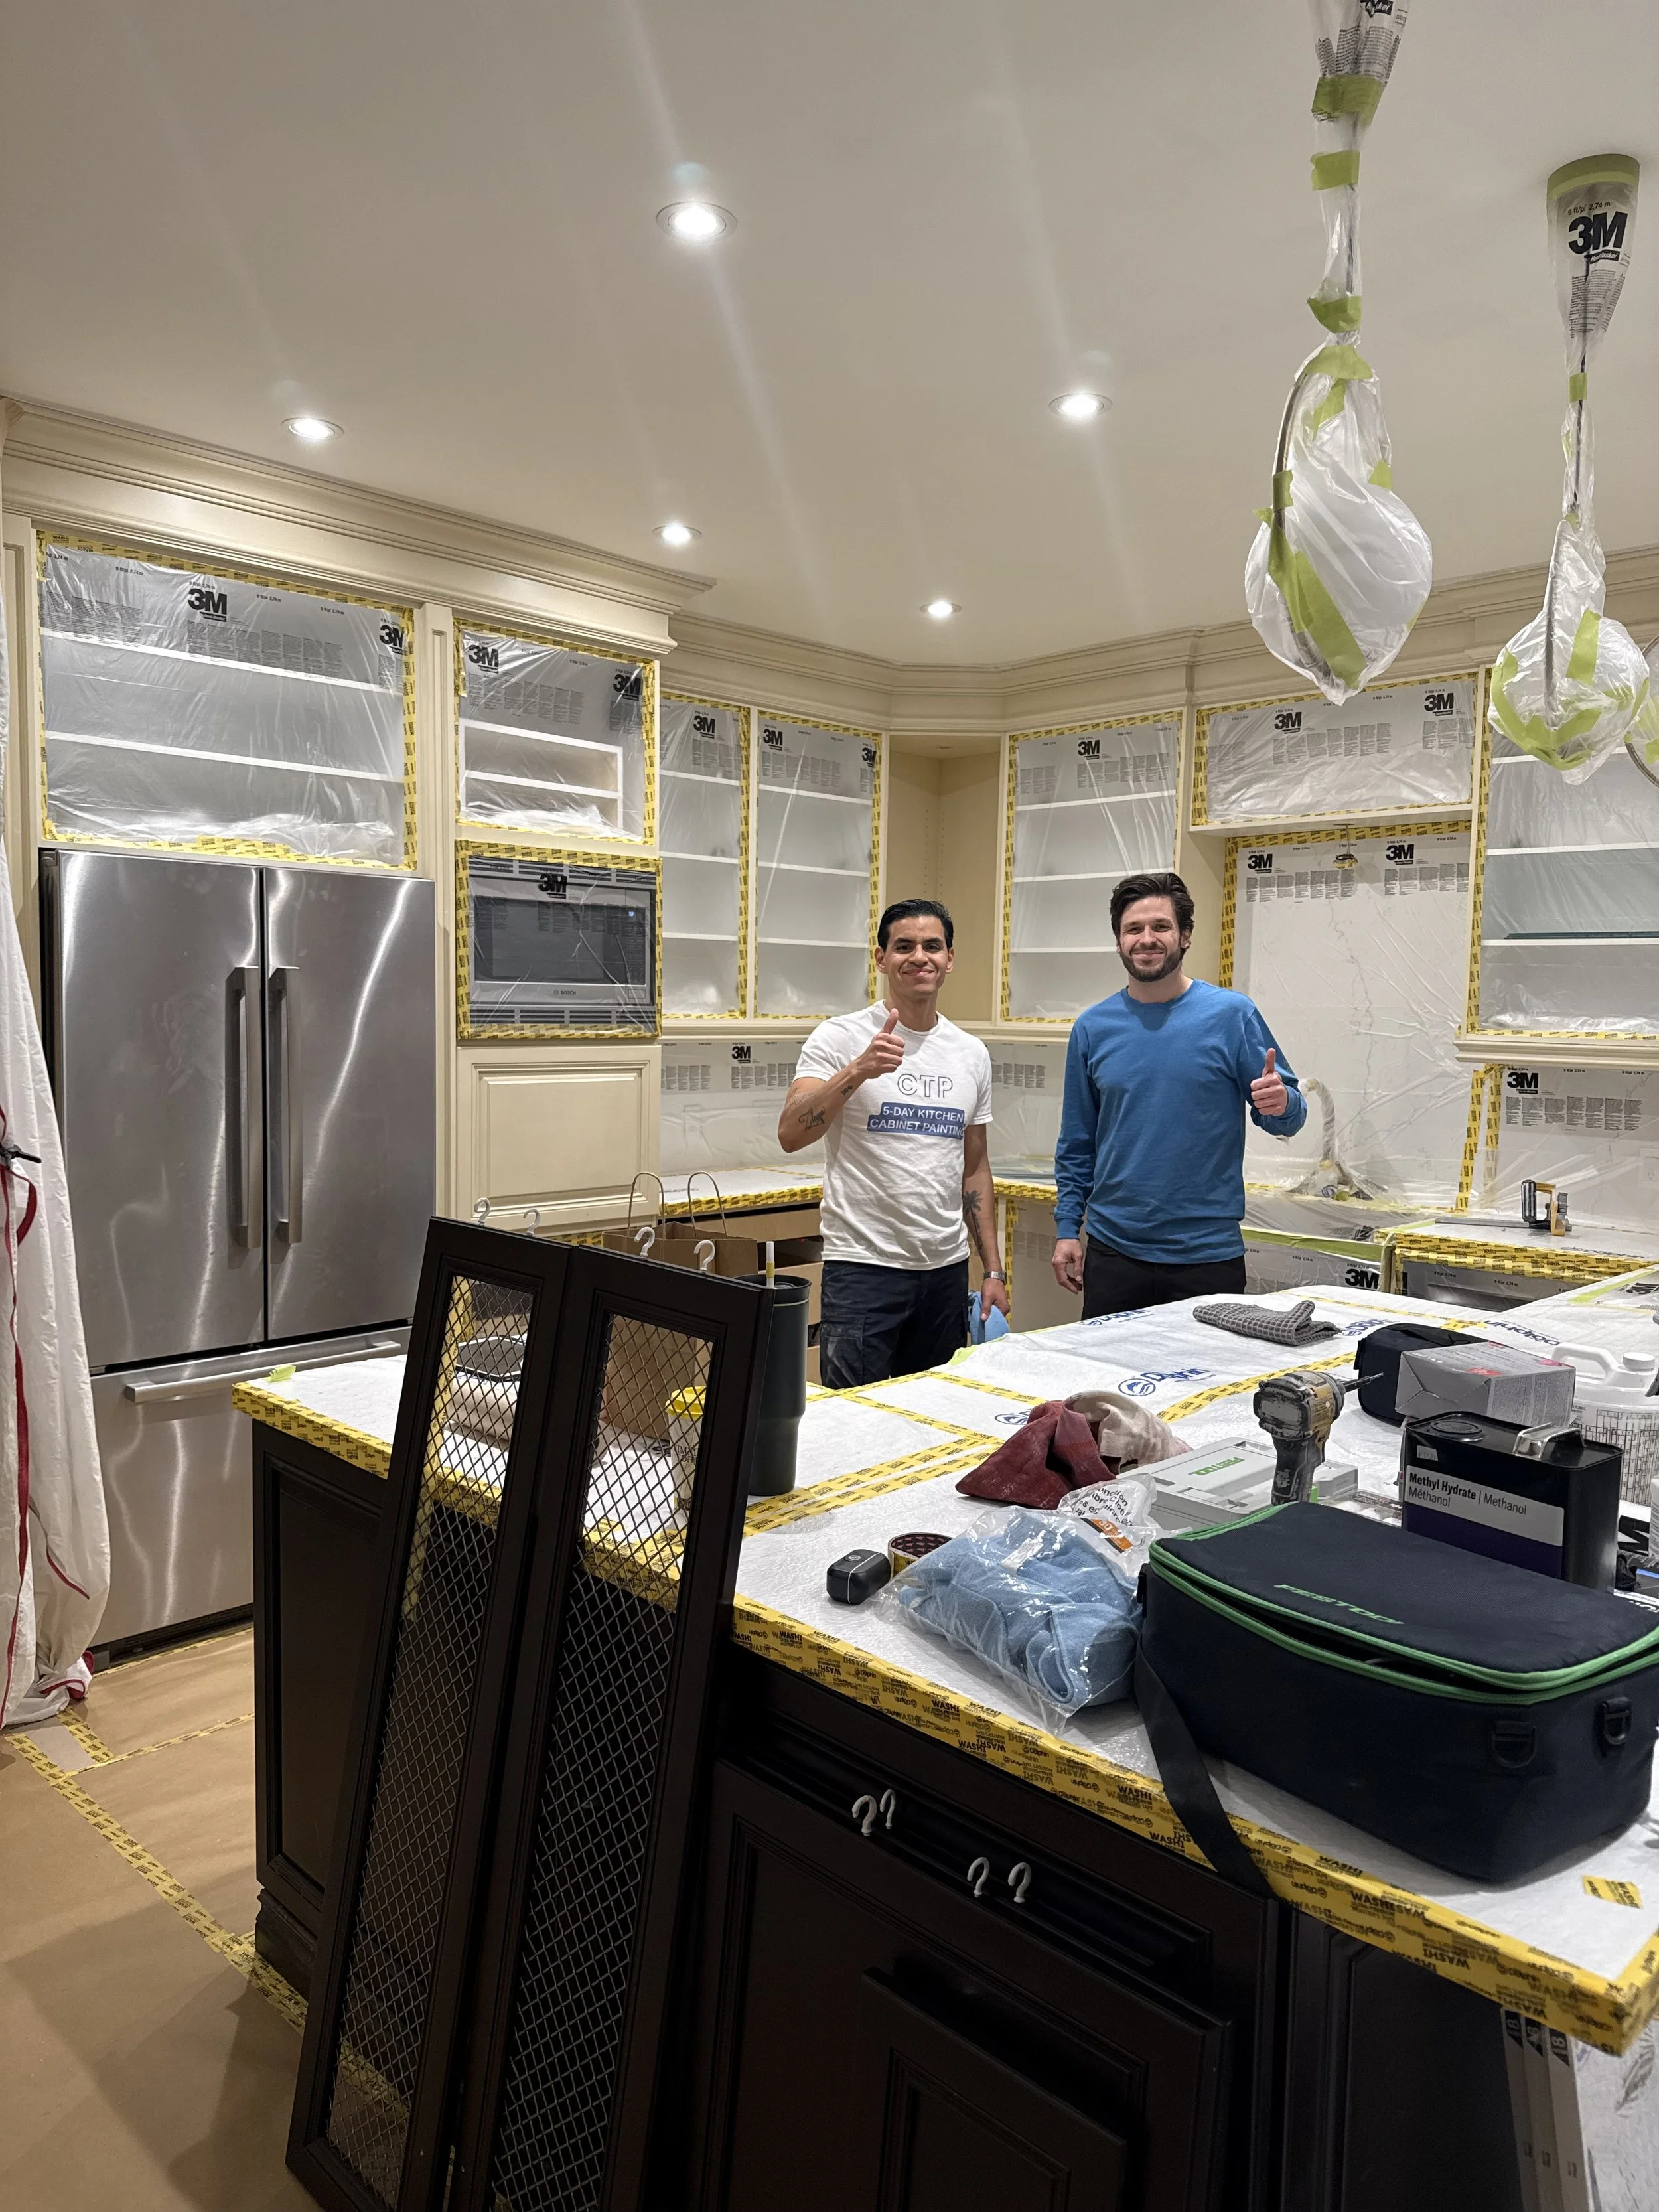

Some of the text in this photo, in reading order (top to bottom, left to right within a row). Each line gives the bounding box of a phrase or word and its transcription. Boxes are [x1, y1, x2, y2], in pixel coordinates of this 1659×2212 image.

[1569, 211, 1628, 254] 3M
[188, 588, 227, 615] 3M
[469, 644, 498, 667] 3M
[613, 674, 641, 695] 3M
[1424, 692, 1454, 711] 3M
[693, 716, 715, 734] 3M
[1274, 712, 1302, 730] 3M
[764, 728, 783, 746] 3M
[1078, 740, 1100, 756] 3M
[1386, 844, 1414, 860] 3M
[1247, 854, 1273, 870] 3M
[539, 873, 567, 893] 3M
[732, 1046, 751, 1059] 3M
[897, 1073, 953, 1098] CTP
[1507, 1072, 1539, 1088] 3M
[883, 1106, 964, 1122] 5-DAY KITCHEN
[870, 1119, 920, 1130] CABINET
[1345, 1268, 1380, 1289] 3M
[1409, 1473, 1526, 1515] Methyl Hydrate Methanol
[1409, 1487, 1451, 1507] Méthanol
[1274, 1584, 1404, 1625] FESTOOL
[780, 1631, 803, 1641] WASHI
[814, 1631, 841, 1643] WASHI
[818, 1664, 841, 1676] WASHI
[932, 1700, 960, 1712] WASHI
[970, 1702, 1001, 1716] WASHI
[958, 1740, 986, 1753] WASHI
[1118, 1785, 1152, 1800] WASHI
[1149, 1831, 1185, 1848] WASHI
[1319, 1856, 1364, 1874] WASHI
[1618, 1881, 1642, 1909] WASHI
[1423, 1947, 1470, 1970] WASHI
